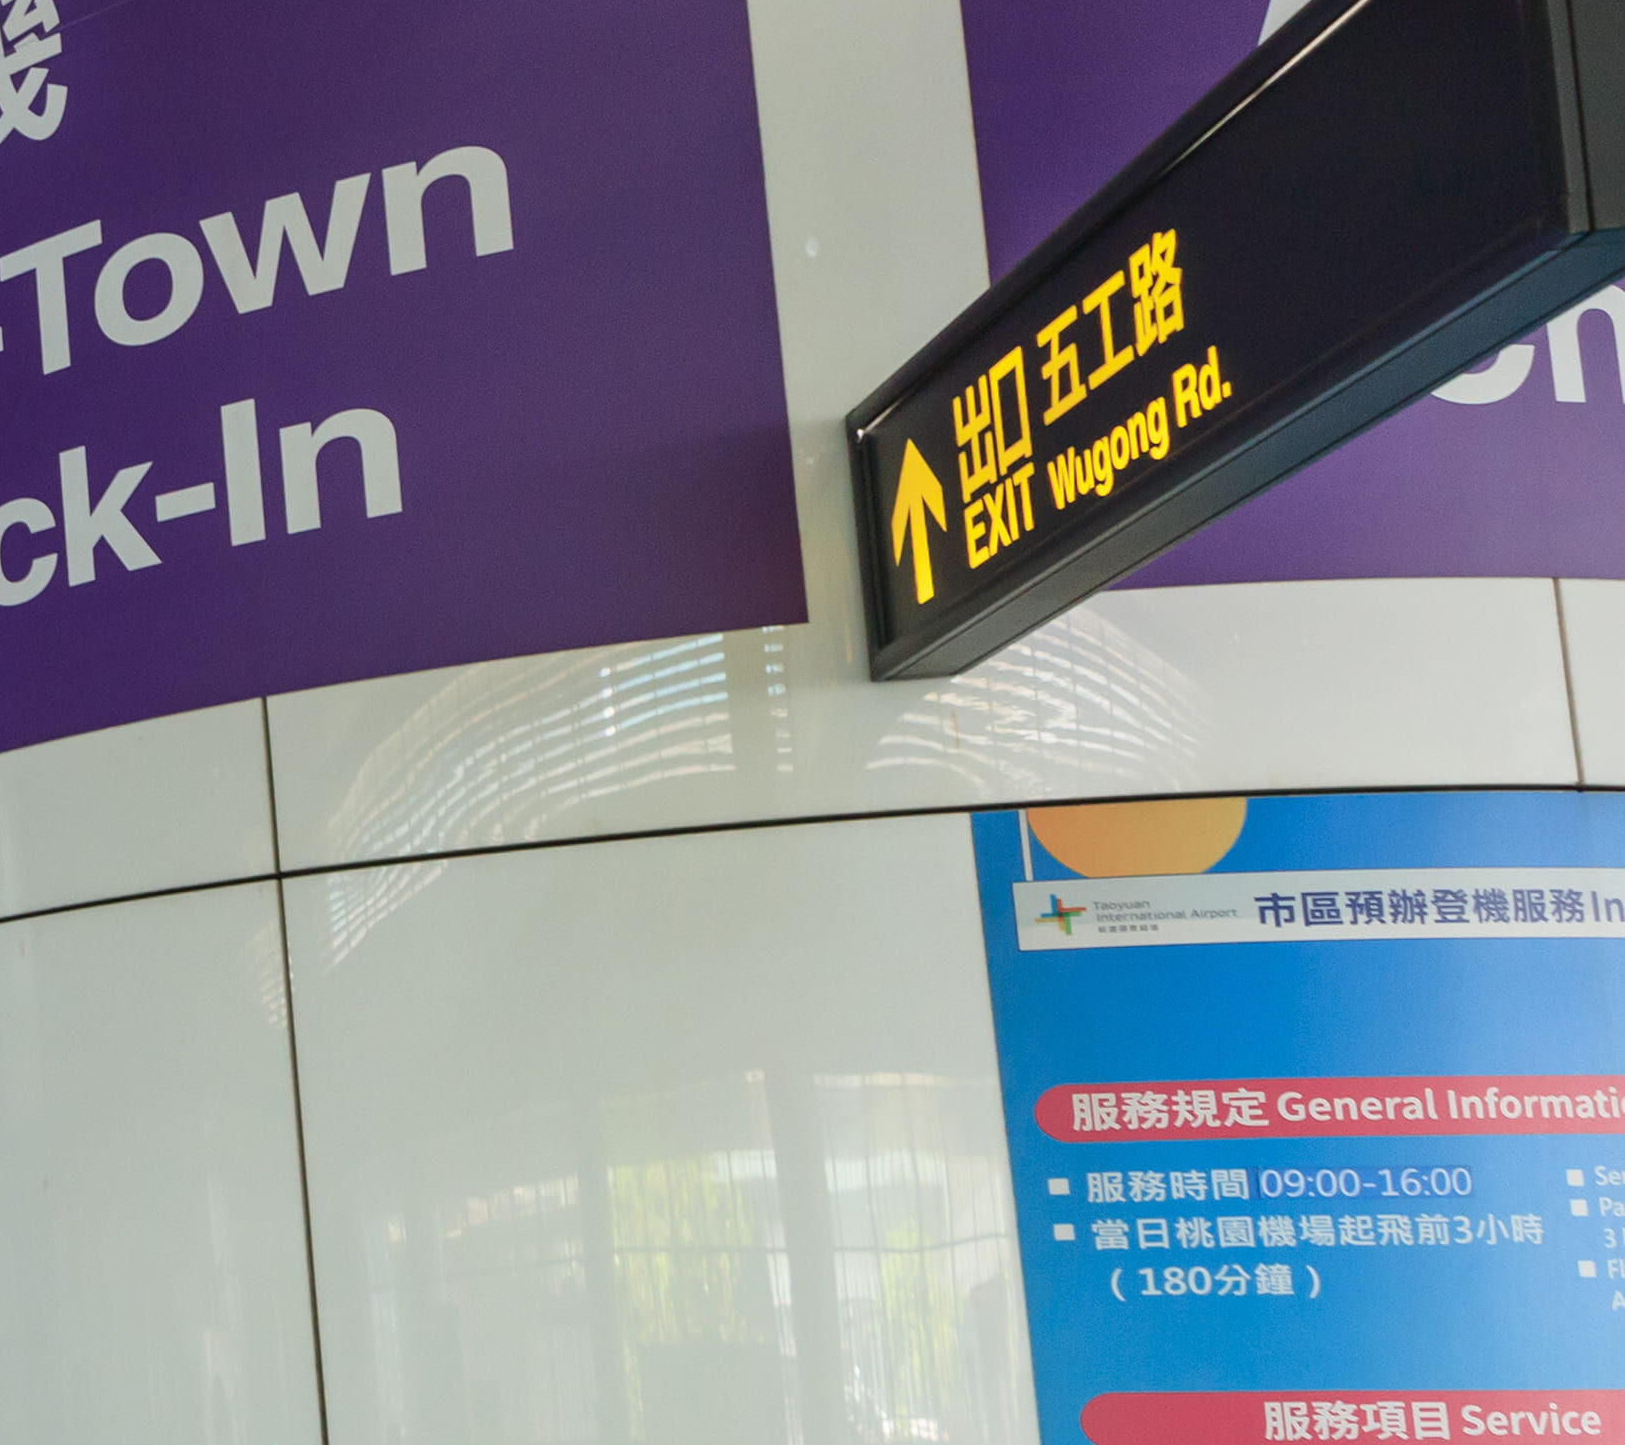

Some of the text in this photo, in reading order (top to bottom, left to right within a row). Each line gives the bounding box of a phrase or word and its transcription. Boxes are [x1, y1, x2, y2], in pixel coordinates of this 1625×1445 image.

[952, 228, 1184, 504] 出口 五工路
[963, 345, 1232, 570] EXIT Wugong Rd.
[1093, 900, 1150, 912] Taoyuan
[1097, 908, 1238, 922] International Airport
[1254, 889, 1585, 928] 市區預辦登機服務
[1071, 1086, 1625, 1133] 服務規定 General Informati
[1086, 1168, 1472, 1204] 服務時間 09:00-16:00
[1091, 1213, 1544, 1251] 當日桃園機場起飛前3小時
[1264, 1401, 1602, 1441] 服務項目 Service
